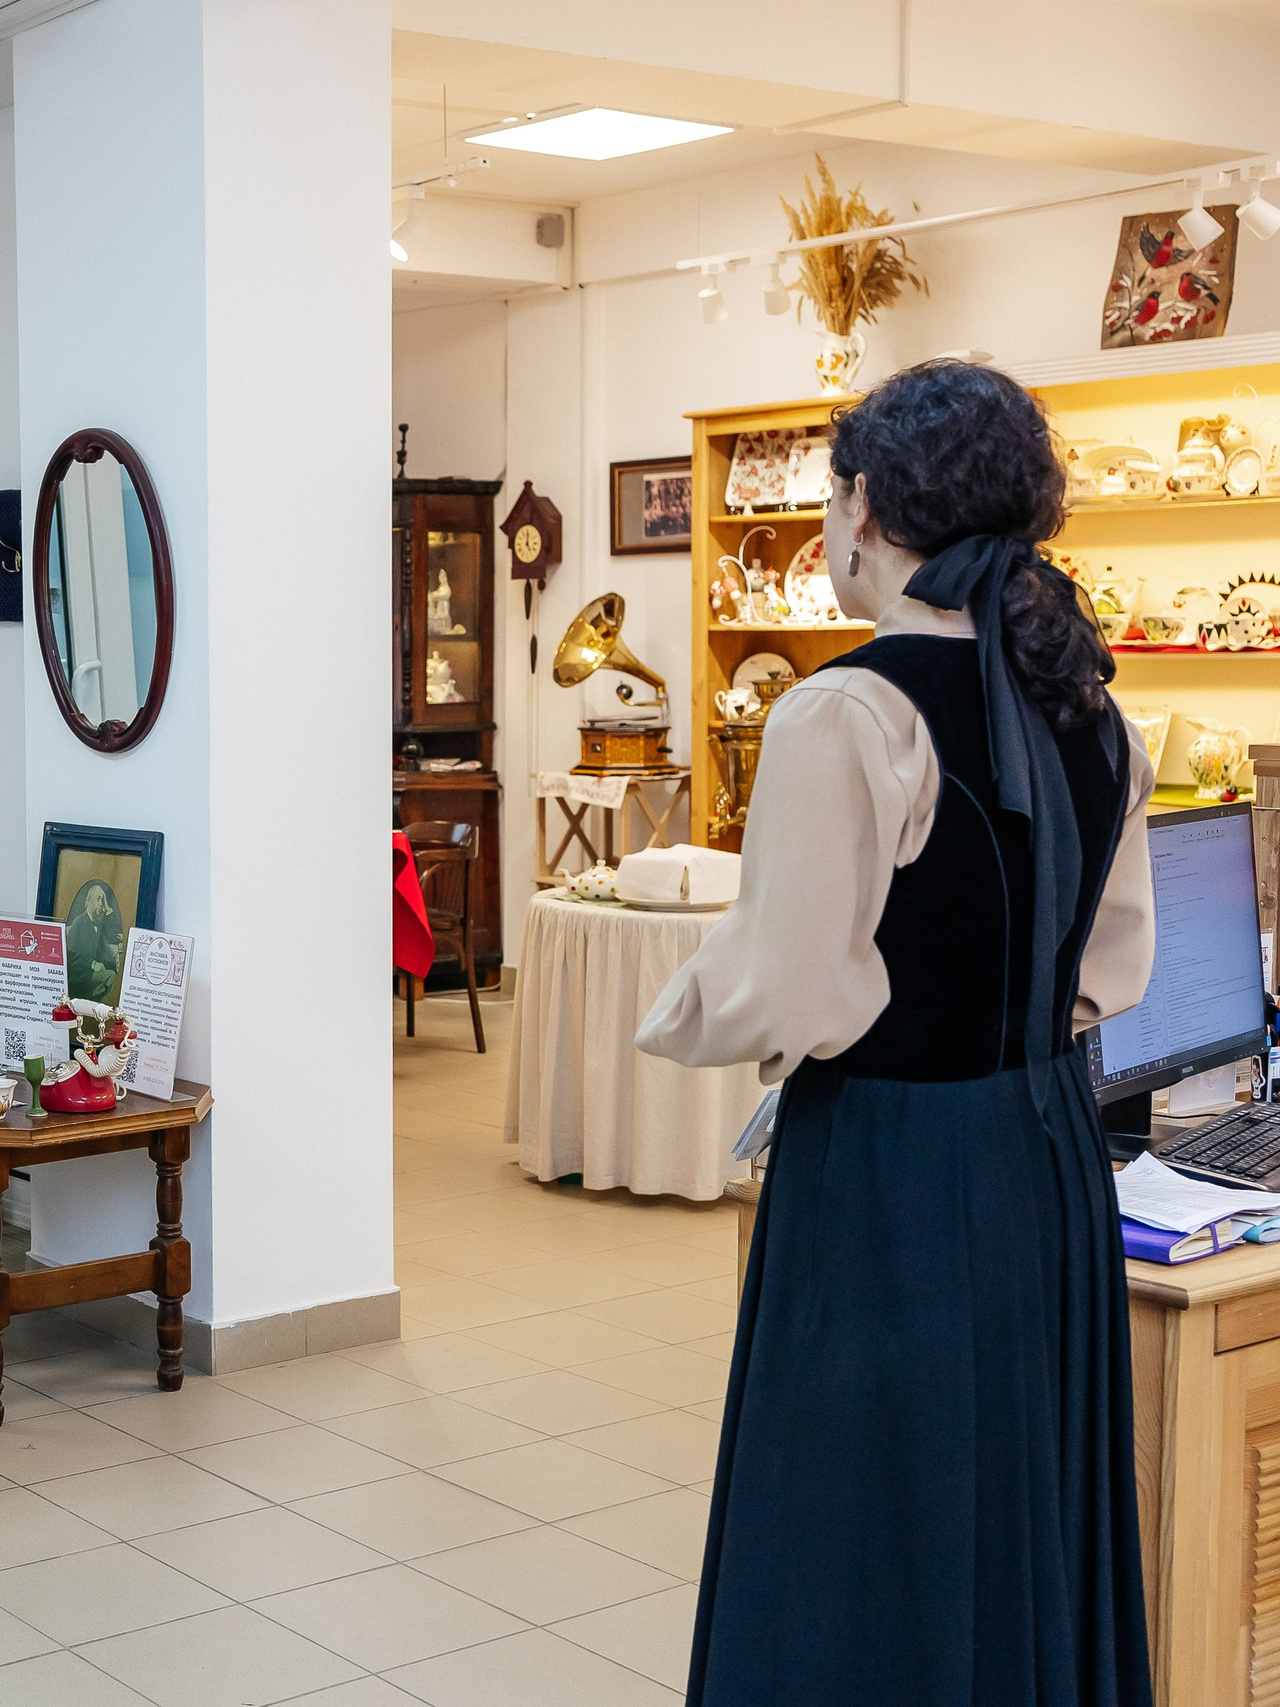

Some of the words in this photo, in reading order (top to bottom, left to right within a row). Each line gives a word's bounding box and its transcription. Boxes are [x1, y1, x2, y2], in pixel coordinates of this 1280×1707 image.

[1, 962, 22, 970] ФАБРИКА
[47, 968, 64, 976] ЗАБАВА
[4, 979, 31, 989] фарфоровое
